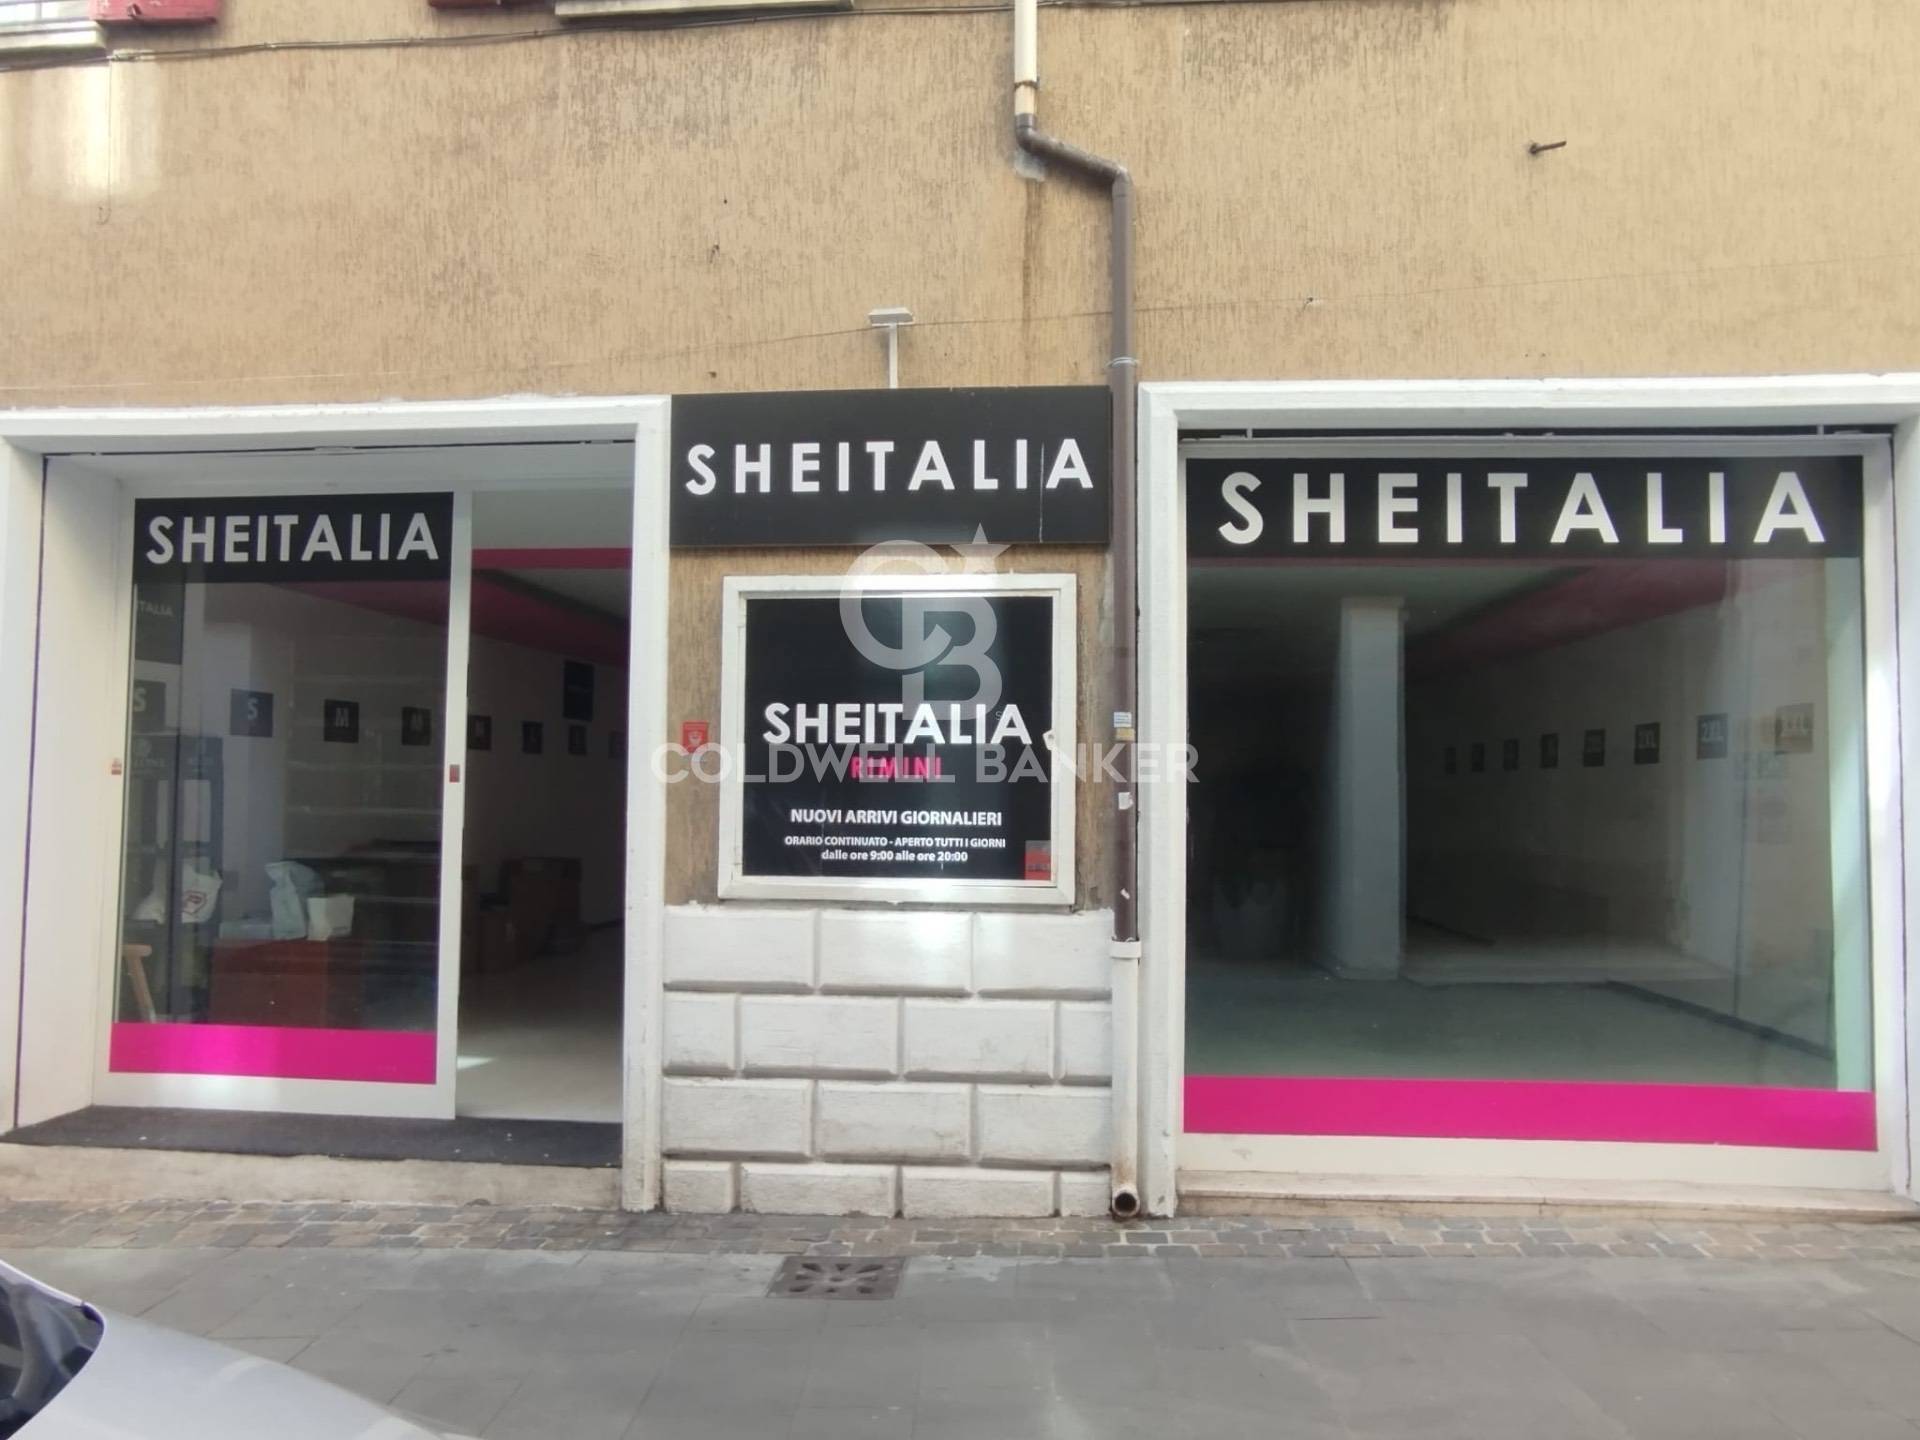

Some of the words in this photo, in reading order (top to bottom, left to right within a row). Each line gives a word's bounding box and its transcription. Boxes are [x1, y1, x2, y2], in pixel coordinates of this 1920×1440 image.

[686, 438, 1094, 496] SHEITALIA
[1218, 471, 1826, 546] SHEITALIA
[146, 512, 440, 565] SHEITALIA
[247, 697, 259, 720] S
[763, 703, 1032, 745] SHEITALIA
[850, 756, 942, 780] RIMINI
[790, 808, 843, 824] NUOVI
[844, 809, 898, 825] ARRIVI
[900, 810, 1003, 827] GIORNALIERI
[784, 835, 823, 847] ORARIO
[824, 836, 888, 847] CONTINUATO
[894, 836, 933, 848] APERTO
[934, 837, 964, 849] TUTTI
[970, 838, 1006, 849] GIORNI
[821, 848, 848, 861] dalle
[850, 852, 869, 861] ore
[870, 850, 894, 862] 9:00
[895, 849, 916, 862] alle
[917, 852, 936, 863] ore
[937, 850, 969, 863] 20:00
